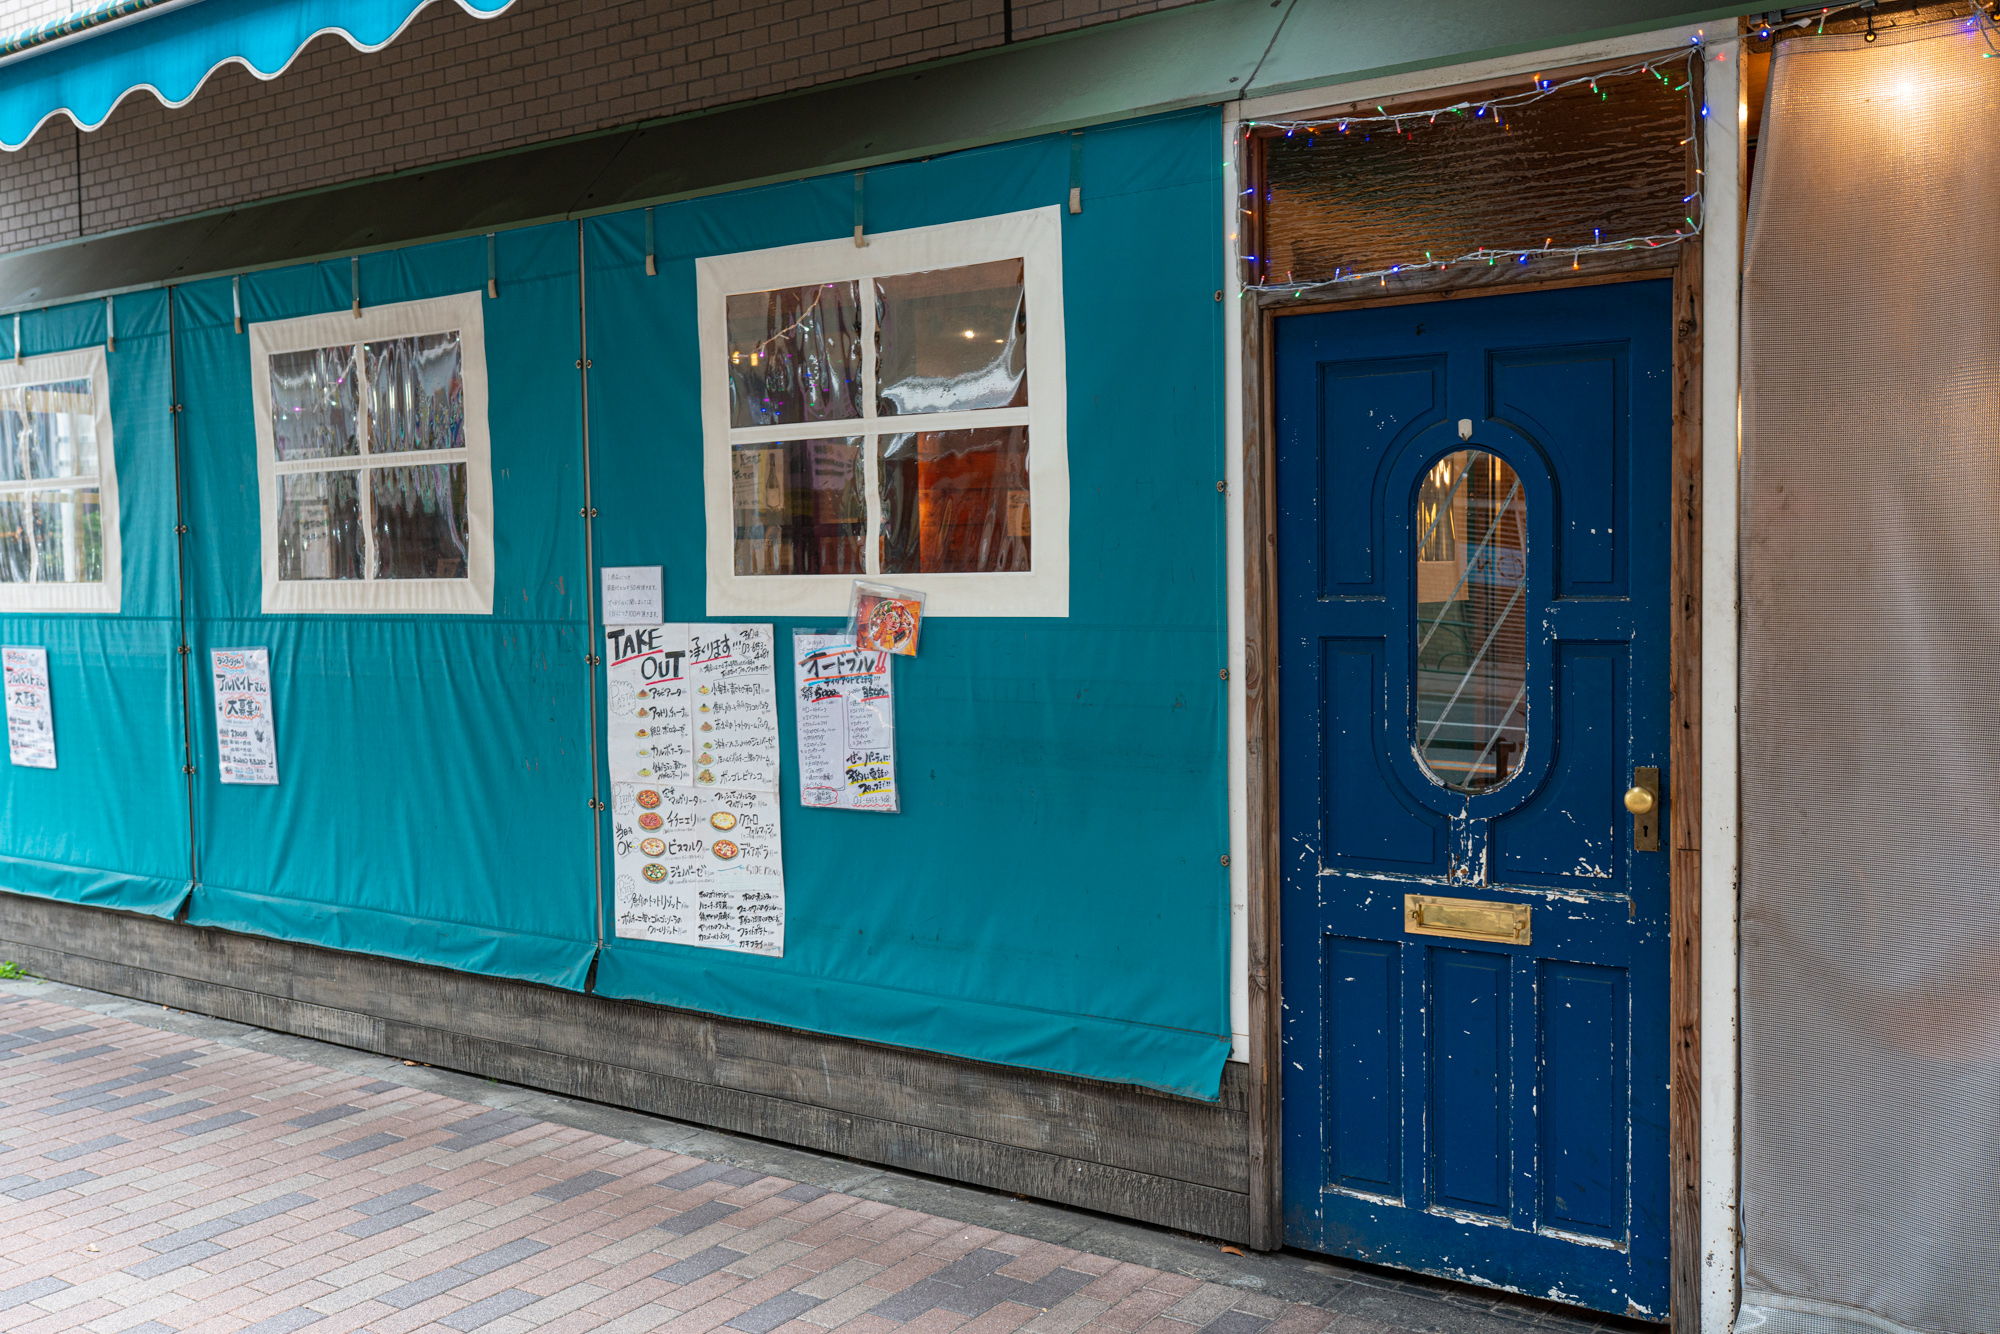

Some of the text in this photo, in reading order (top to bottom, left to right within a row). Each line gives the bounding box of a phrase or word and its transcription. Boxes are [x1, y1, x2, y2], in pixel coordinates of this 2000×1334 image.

[607, 627, 663, 661] TAKE
[641, 650, 686, 680] OUT
[216, 673, 266, 692] アルバイトさん
[227, 699, 260, 717] 大募集!!
[650, 743, 683, 758] カルボナーラ
[668, 838, 703, 855] ビスマルク
[740, 843, 769, 859] ディアボラ
[746, 864, 762, 875] SIDE
